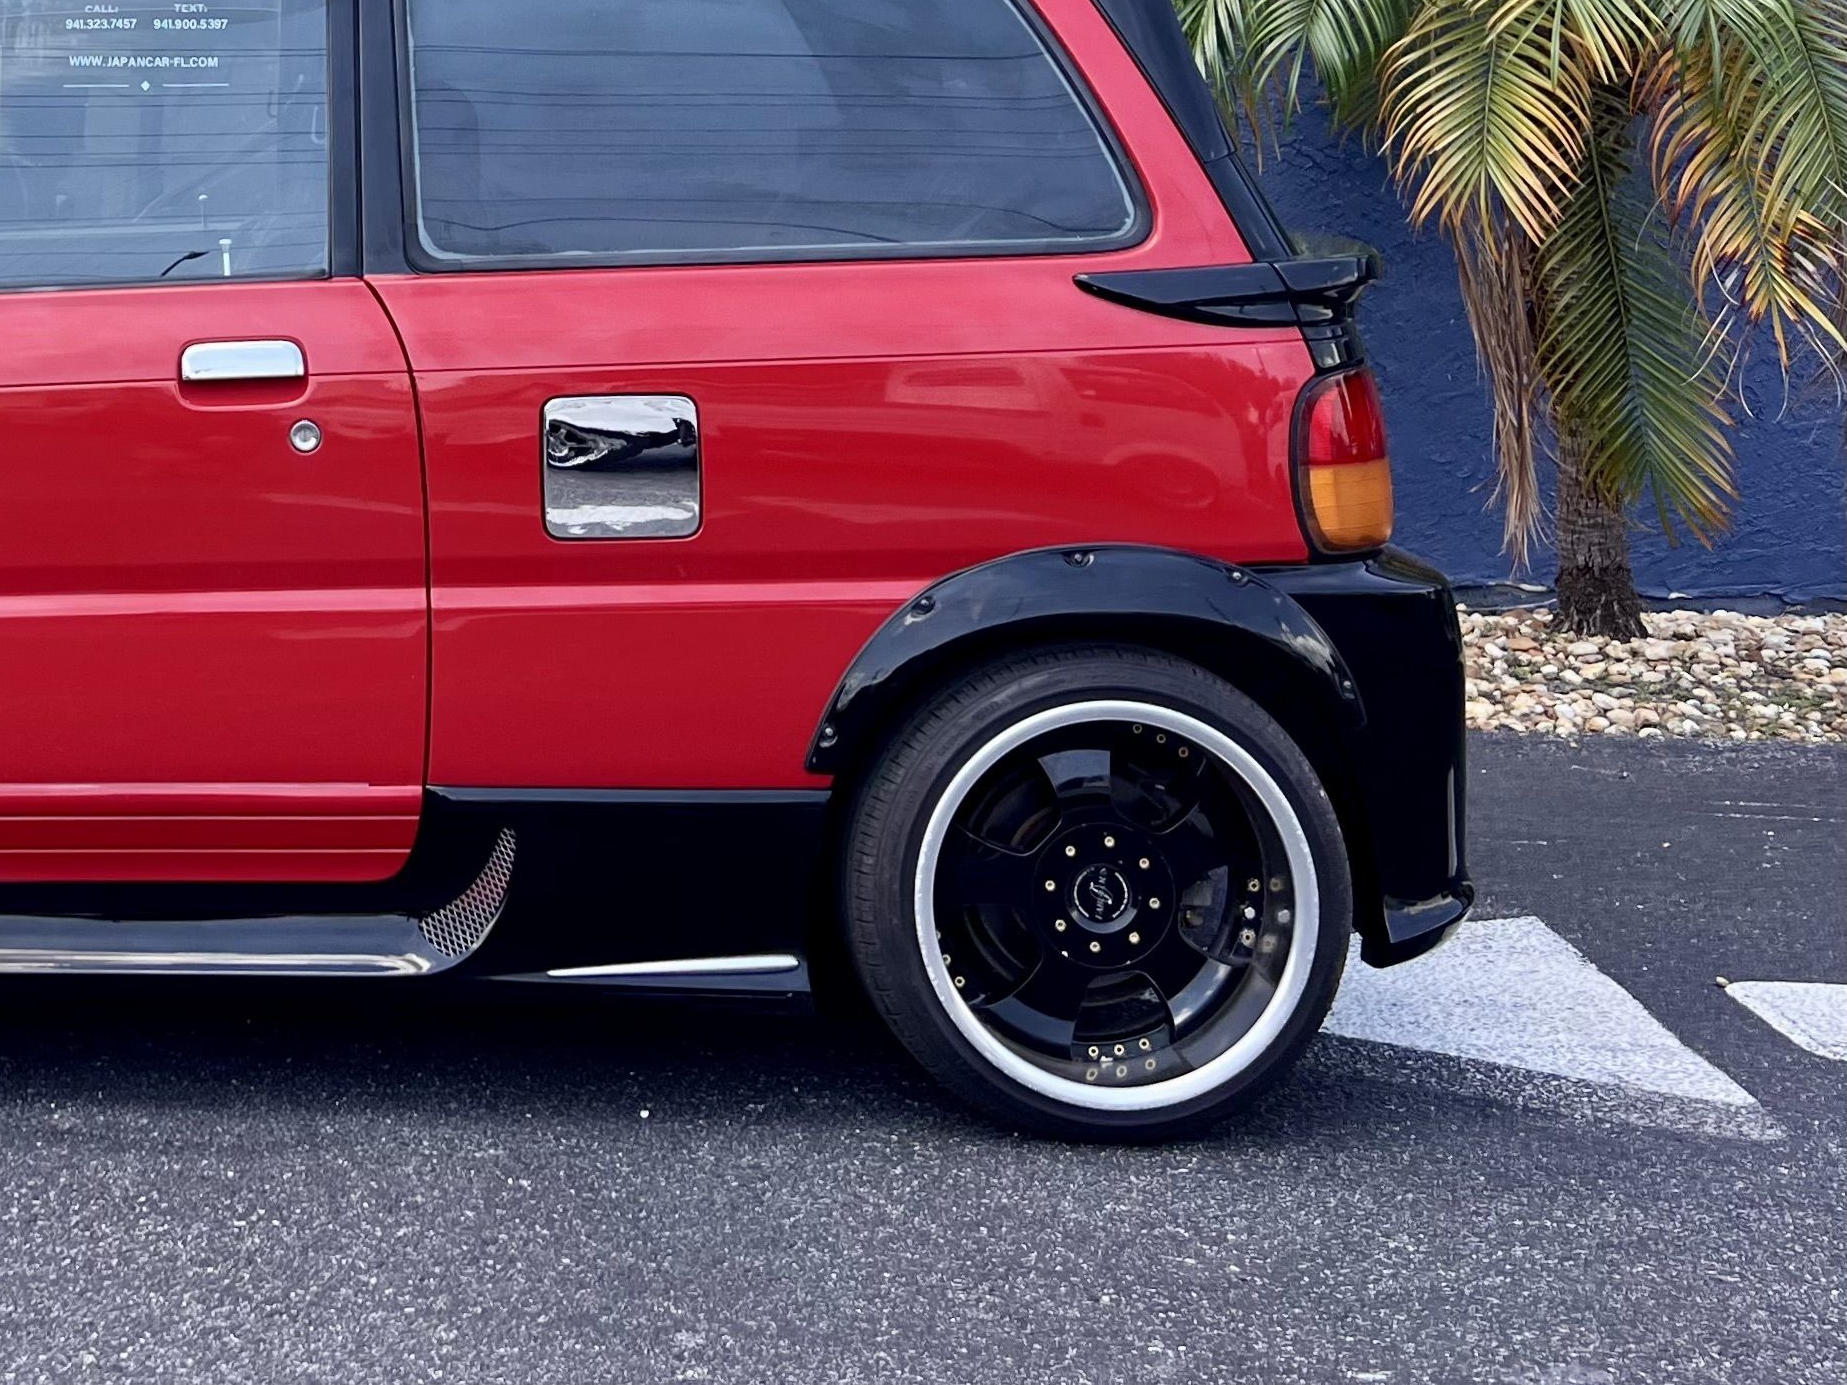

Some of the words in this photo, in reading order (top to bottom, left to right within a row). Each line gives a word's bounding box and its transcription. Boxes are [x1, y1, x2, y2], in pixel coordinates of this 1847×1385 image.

[84, 4, 119, 14] CALL:
[173, 3, 208, 14] TEXT:
[65, 18, 138, 30] 941.323.7457
[153, 18, 228, 30] 941.900.5397
[68, 55, 219, 68] WWW.JAPANCAR-FL.COM
